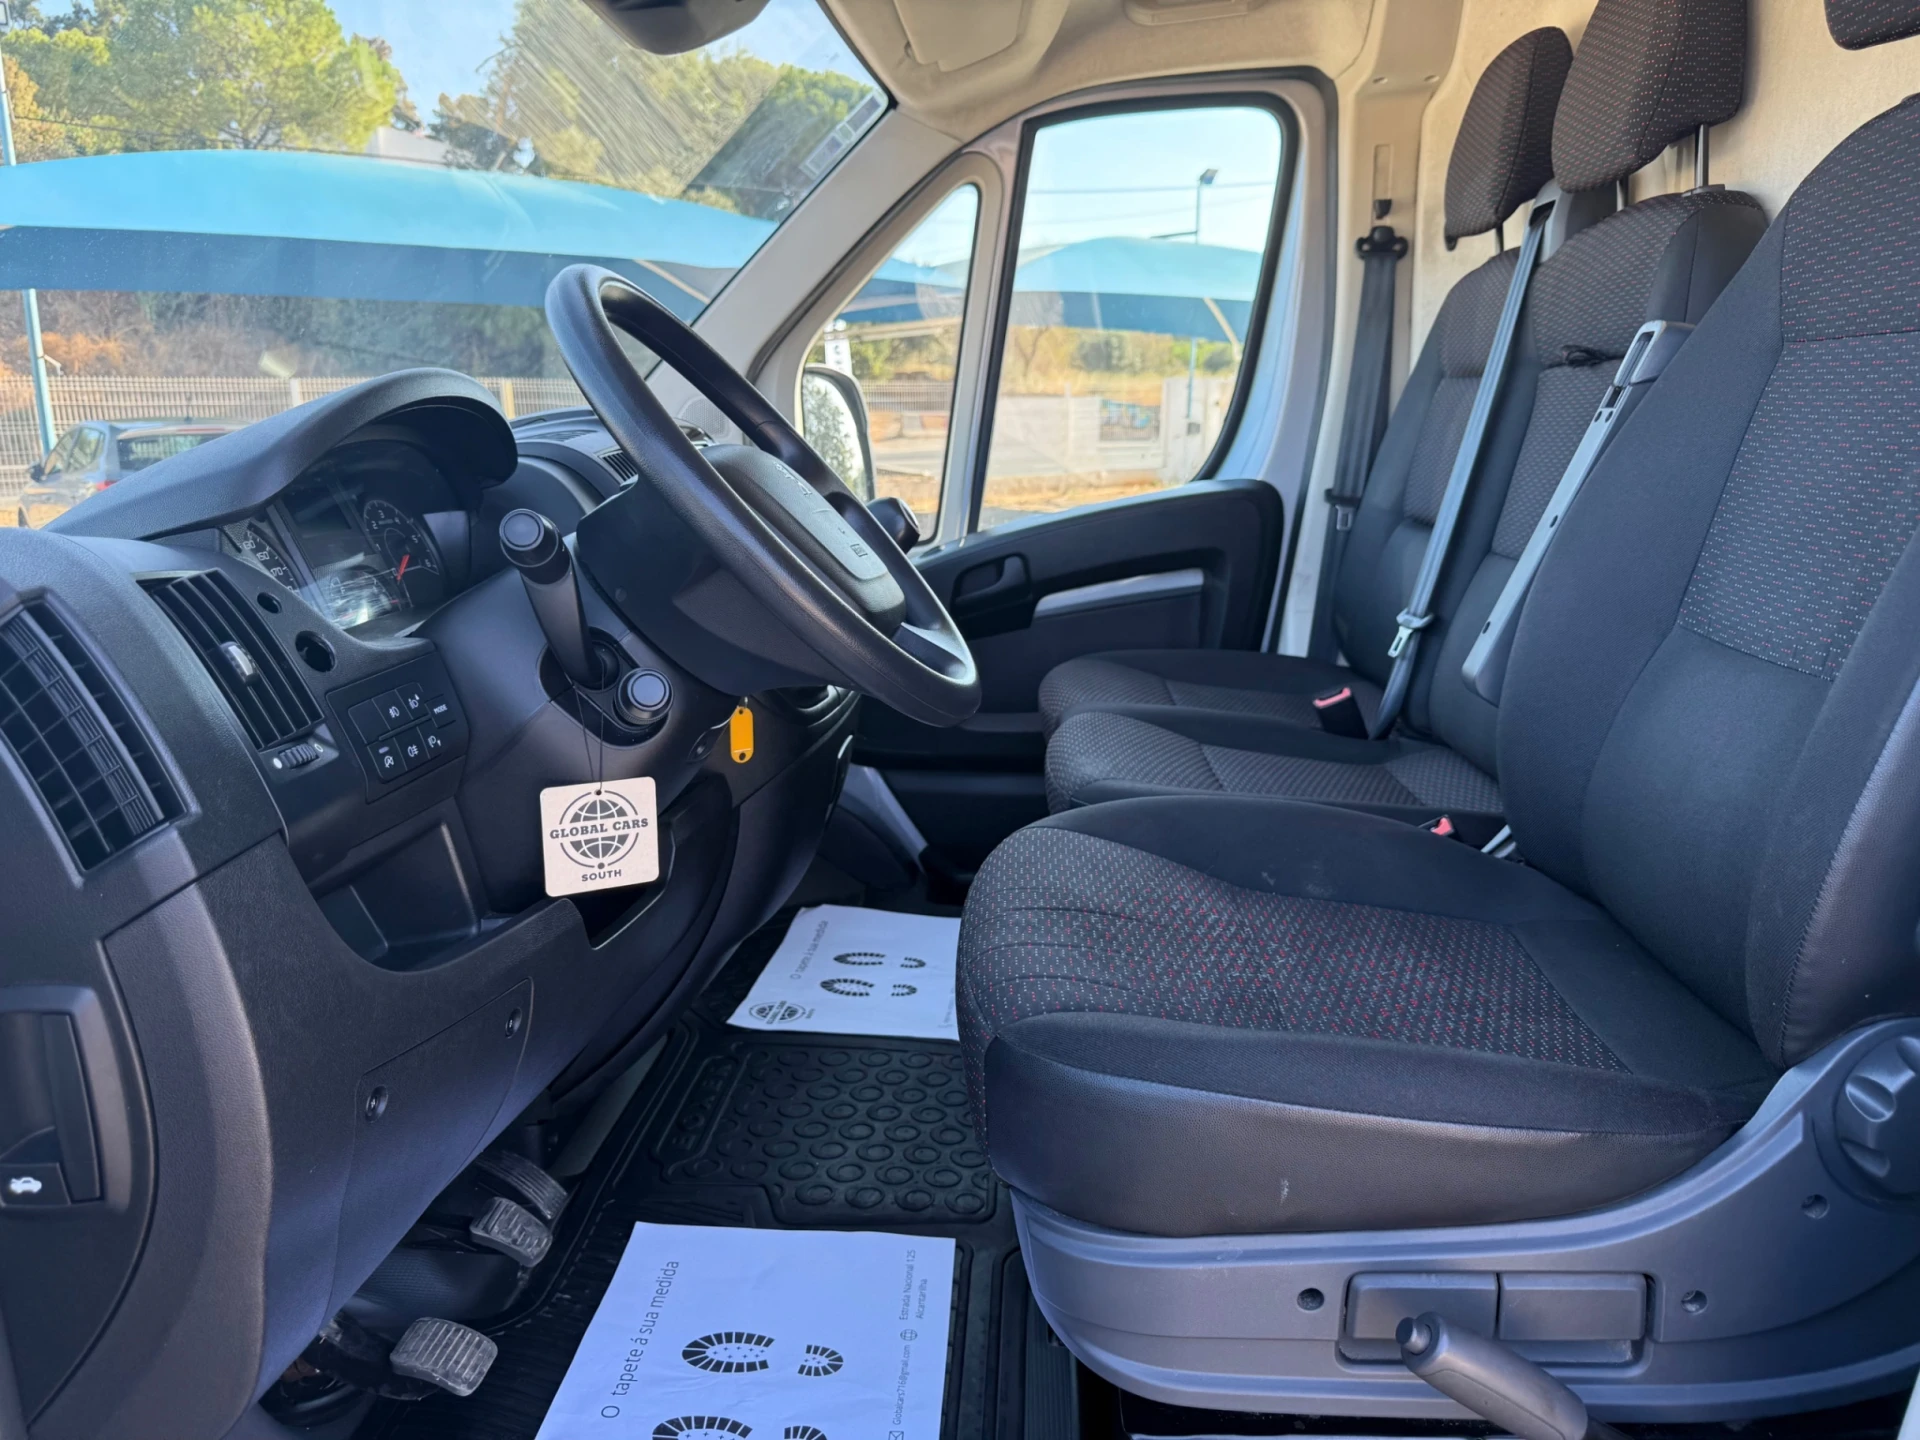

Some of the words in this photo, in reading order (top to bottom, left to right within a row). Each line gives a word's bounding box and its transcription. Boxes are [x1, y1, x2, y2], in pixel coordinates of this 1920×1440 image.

[433, 704, 448, 715] MODE
[550, 823, 608, 839] GLOBAL
[612, 818, 649, 831] CARS
[581, 869, 622, 882] SOUTH
[906, 1249, 916, 1262] 125
[650, 1260, 680, 1308] medida
[902, 1264, 914, 1293] Nacional
[898, 1294, 911, 1320] Estrada
[639, 1311, 659, 1335] sua
[610, 1348, 644, 1396] tapete
[601, 1405, 620, 1419] O
